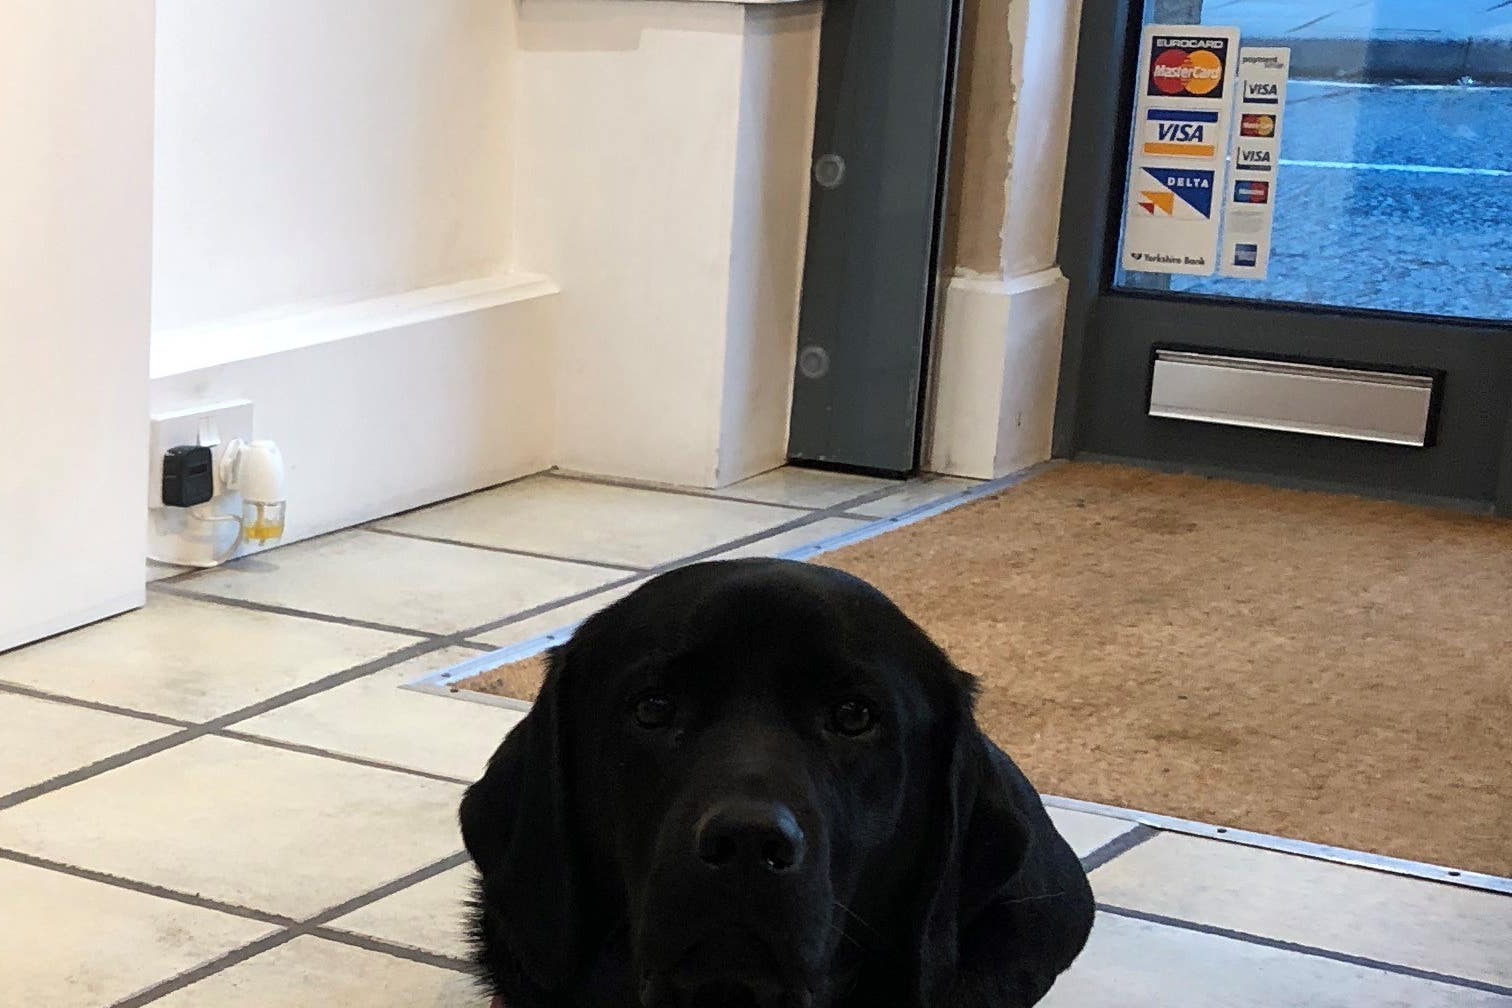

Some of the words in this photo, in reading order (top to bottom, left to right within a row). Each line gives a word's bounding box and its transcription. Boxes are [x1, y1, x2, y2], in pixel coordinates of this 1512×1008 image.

[1156, 38, 1224, 49] EUROCARD
[1153, 64, 1223, 80] MasterCard
[1249, 83, 1278, 96] VISA
[1158, 122, 1204, 143] VISA
[1242, 150, 1271, 163] VISA
[1167, 176, 1210, 189] DELTA
[1144, 253, 1182, 265] Yorkshire
[1184, 256, 1205, 266] Bank
